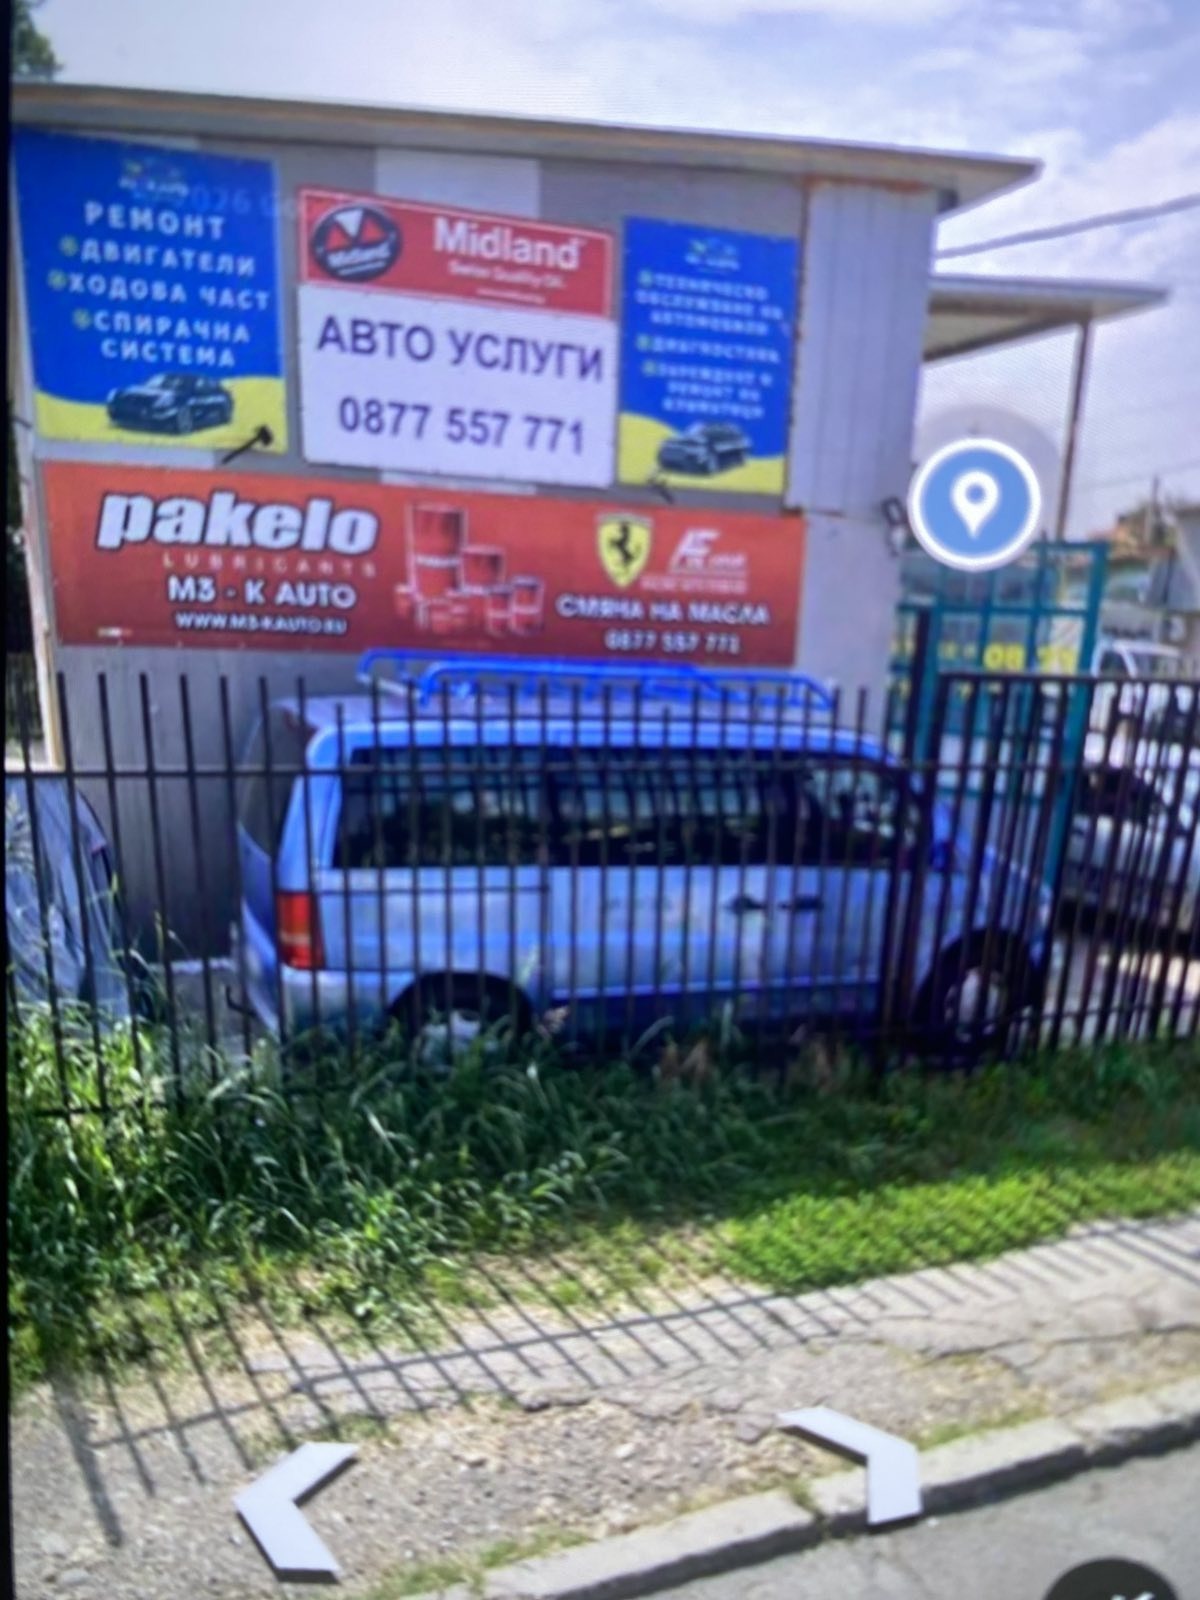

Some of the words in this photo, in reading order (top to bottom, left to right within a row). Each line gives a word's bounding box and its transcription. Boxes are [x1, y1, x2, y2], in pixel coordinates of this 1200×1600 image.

[85, 201, 225, 239] РЕМОНТ
[81, 239, 255, 275] ДВИГАТЕЛИ
[434, 217, 579, 269] Midland
[69, 273, 186, 302] ХОДОВА
[199, 286, 269, 310] ЧАСТ
[94, 310, 249, 342] СПИРАЧНА
[102, 339, 235, 366] СИСТЕМА
[318, 316, 433, 360] АВТО
[450, 329, 602, 381] УСЛУГИ
[338, 394, 431, 438] 0877
[446, 407, 510, 444] 557
[523, 413, 584, 453] 771
[97, 491, 379, 554] pakelo
[168, 575, 215, 602] M3
[245, 579, 264, 603] K
[274, 582, 357, 609] AUTO
[650, 601, 681, 620] НА
[689, 603, 769, 624] МАСЛА
[605, 628, 656, 649] 0877
